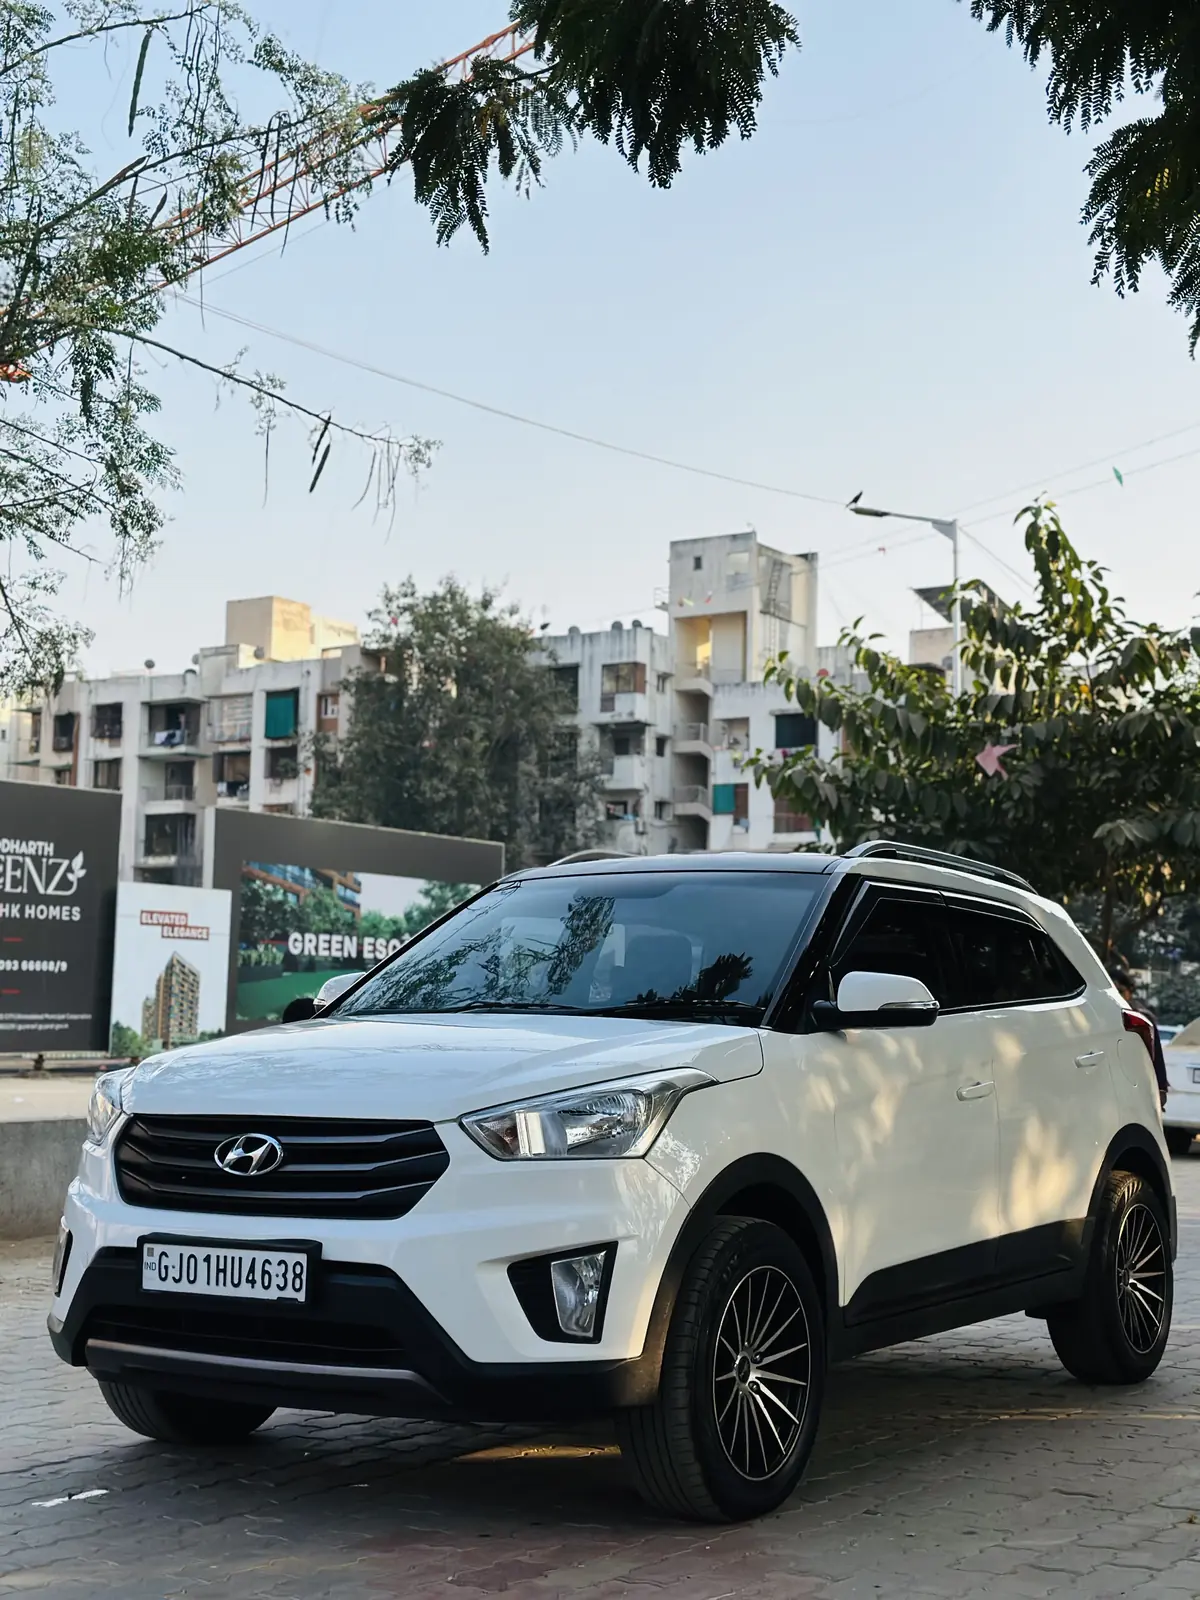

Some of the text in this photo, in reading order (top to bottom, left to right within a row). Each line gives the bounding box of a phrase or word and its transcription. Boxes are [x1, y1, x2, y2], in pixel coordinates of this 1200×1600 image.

[0, 837, 54, 857] DHARTH
[0, 854, 78, 896] ENZ
[24, 904, 81, 922] HOMES
[288, 931, 407, 960] GREEN ESC
[144, 1250, 304, 1293] IND GJ01HU4638
